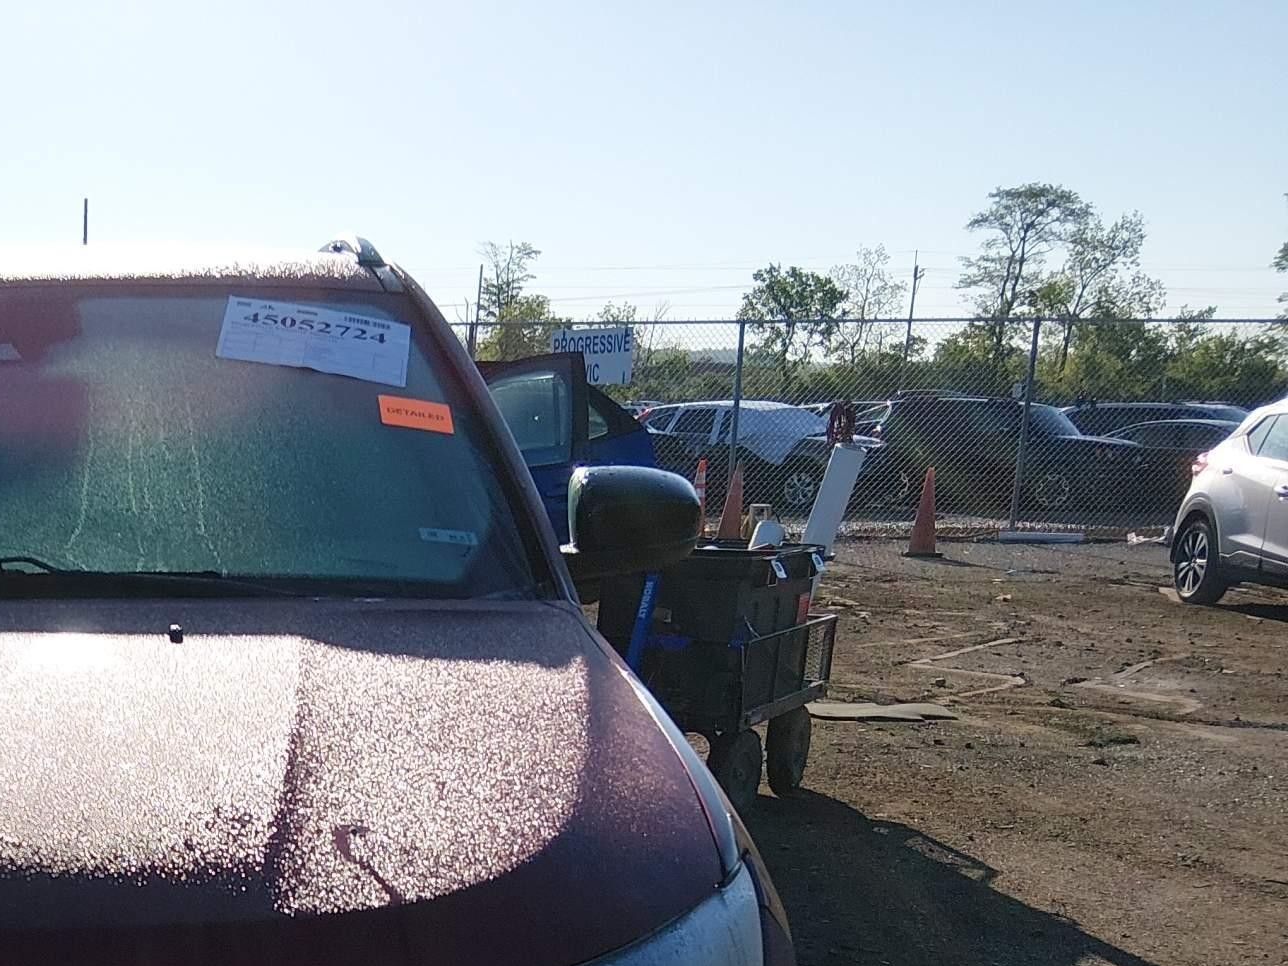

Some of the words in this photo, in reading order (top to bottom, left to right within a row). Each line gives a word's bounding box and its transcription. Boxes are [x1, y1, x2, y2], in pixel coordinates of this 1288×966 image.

[243, 311, 387, 344] 45052724
[554, 333, 631, 354] PROGRESSIVE
[387, 408, 444, 421] DETAILED
